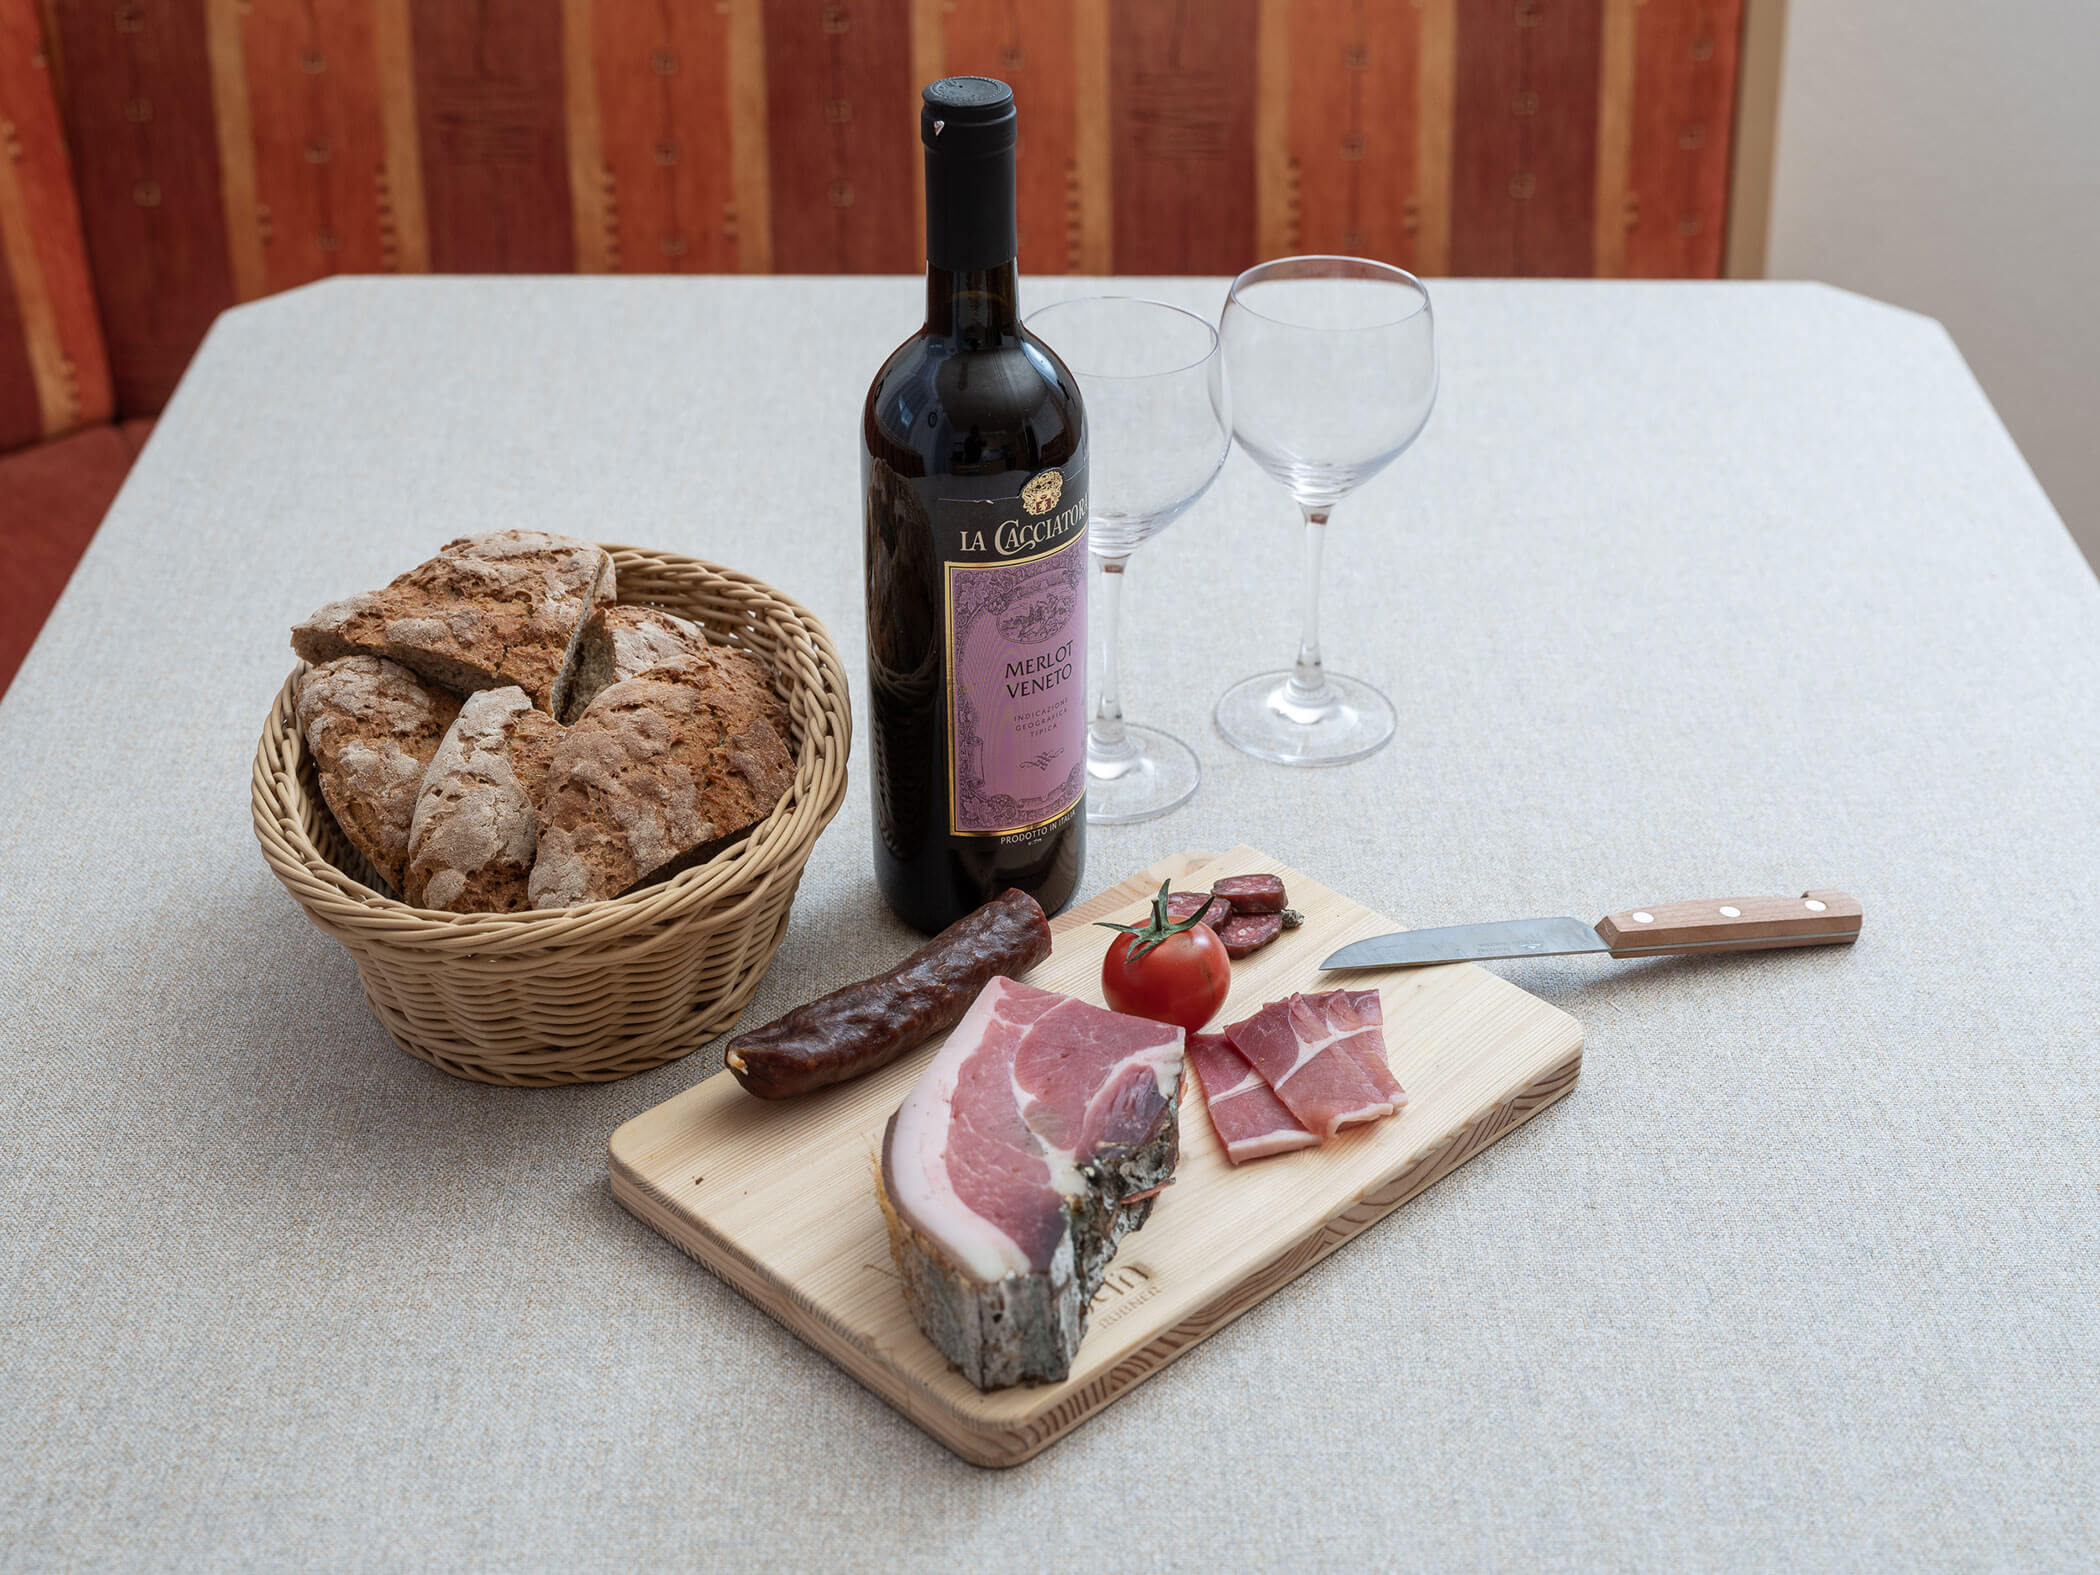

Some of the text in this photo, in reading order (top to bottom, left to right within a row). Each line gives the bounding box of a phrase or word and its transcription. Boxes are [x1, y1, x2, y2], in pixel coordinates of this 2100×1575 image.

[959, 530, 987, 552] LA
[1005, 639, 1074, 679] MERLOT
[1006, 663, 1073, 699] VENETO
[1000, 826, 1048, 846] PRODOTTO
[1049, 821, 1057, 832] IN
